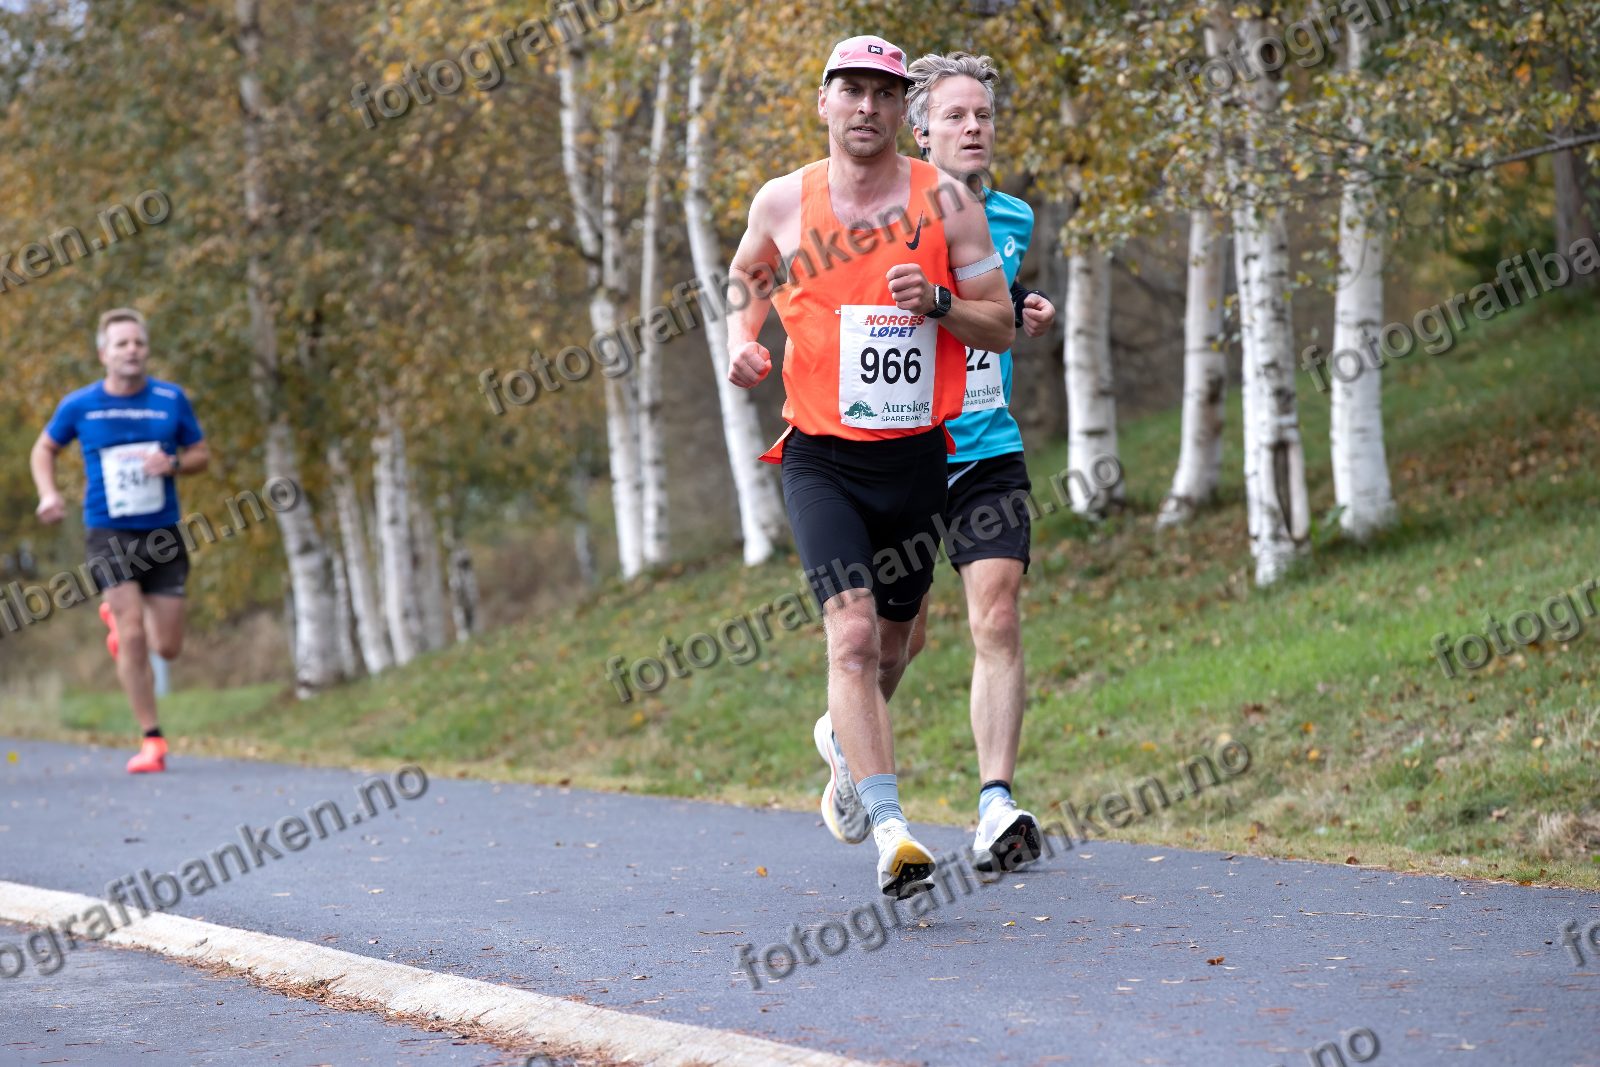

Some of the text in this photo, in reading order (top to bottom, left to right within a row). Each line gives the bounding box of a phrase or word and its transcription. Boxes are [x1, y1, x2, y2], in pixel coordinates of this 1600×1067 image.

[865, 315, 925, 326] NORGES
[870, 326, 916, 338] LØPET
[860, 347, 922, 384] 966
[882, 401, 930, 413] Aurskog
